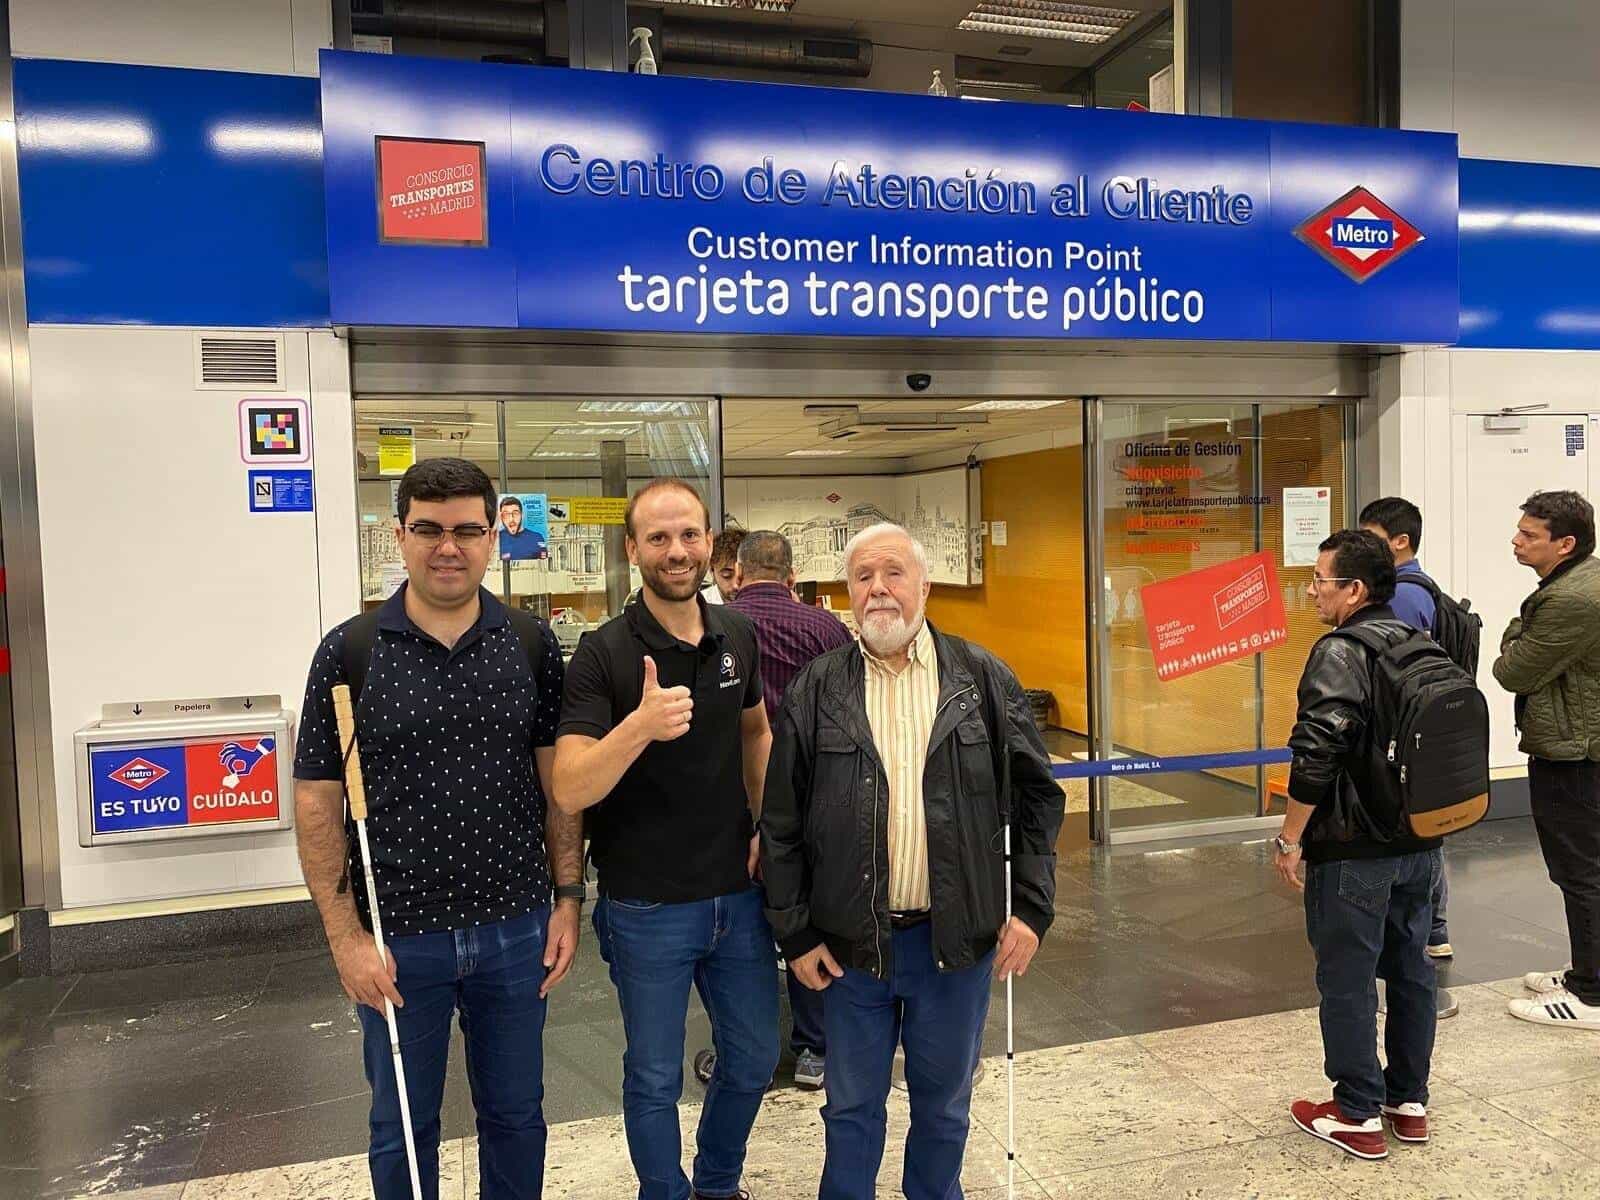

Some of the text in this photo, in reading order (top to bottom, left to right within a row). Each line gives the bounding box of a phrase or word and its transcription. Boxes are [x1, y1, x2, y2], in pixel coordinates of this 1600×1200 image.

[406, 163, 474, 188] CONSORCIO
[539, 143, 1254, 226] Centro de Atención al Cliente
[390, 179, 475, 208] TRANSPORTES
[430, 195, 475, 216] MADRID
[1336, 224, 1389, 245] Metro
[687, 227, 1142, 272] Customer Information Point
[618, 265, 1205, 330] tarjeta transporte público
[1125, 441, 1242, 457] Oficina de Gestión
[1125, 485, 1144, 495] cita
[1220, 580, 1264, 613] TRANSPORTES
[1241, 590, 1266, 611] MADRID
[1158, 624, 1196, 641] transporte
[174, 703, 211, 712] Papelera
[126, 770, 152, 779] Metro
[1111, 763, 1125, 771] Metro
[101, 797, 181, 817] ES TUYO
[193, 789, 273, 810] CUÍDALO
